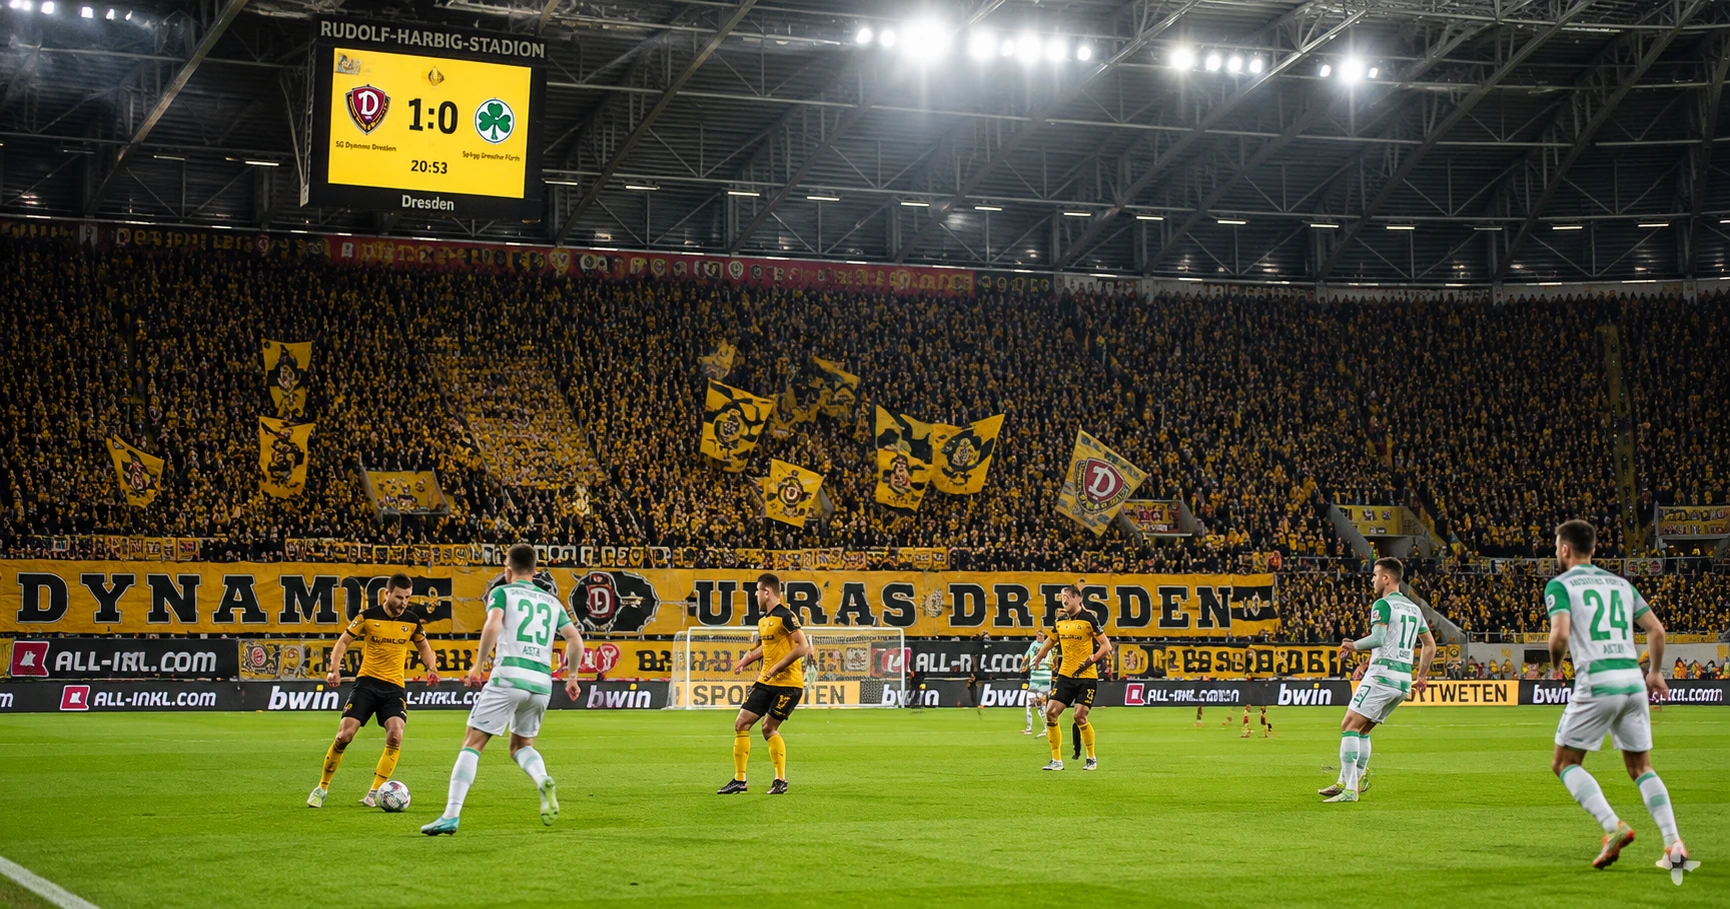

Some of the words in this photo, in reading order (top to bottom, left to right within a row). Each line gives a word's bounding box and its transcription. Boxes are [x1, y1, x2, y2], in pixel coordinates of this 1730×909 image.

[320, 20, 545, 58] RUDOLF-HARBIG-STADION
[408, 98, 458, 134] 1:0
[411, 159, 448, 174] 20:53
[402, 194, 455, 211] Dresden
[516, 598, 552, 647] 23
[1583, 588, 1628, 641] 24
[1399, 614, 1417, 649] 17
[94, 691, 217, 707] ALL-INKL.COM
[268, 684, 339, 710] bwin
[586, 683, 651, 709] bwin
[981, 683, 1029, 707] bwi
[1277, 683, 1332, 705] bwin
